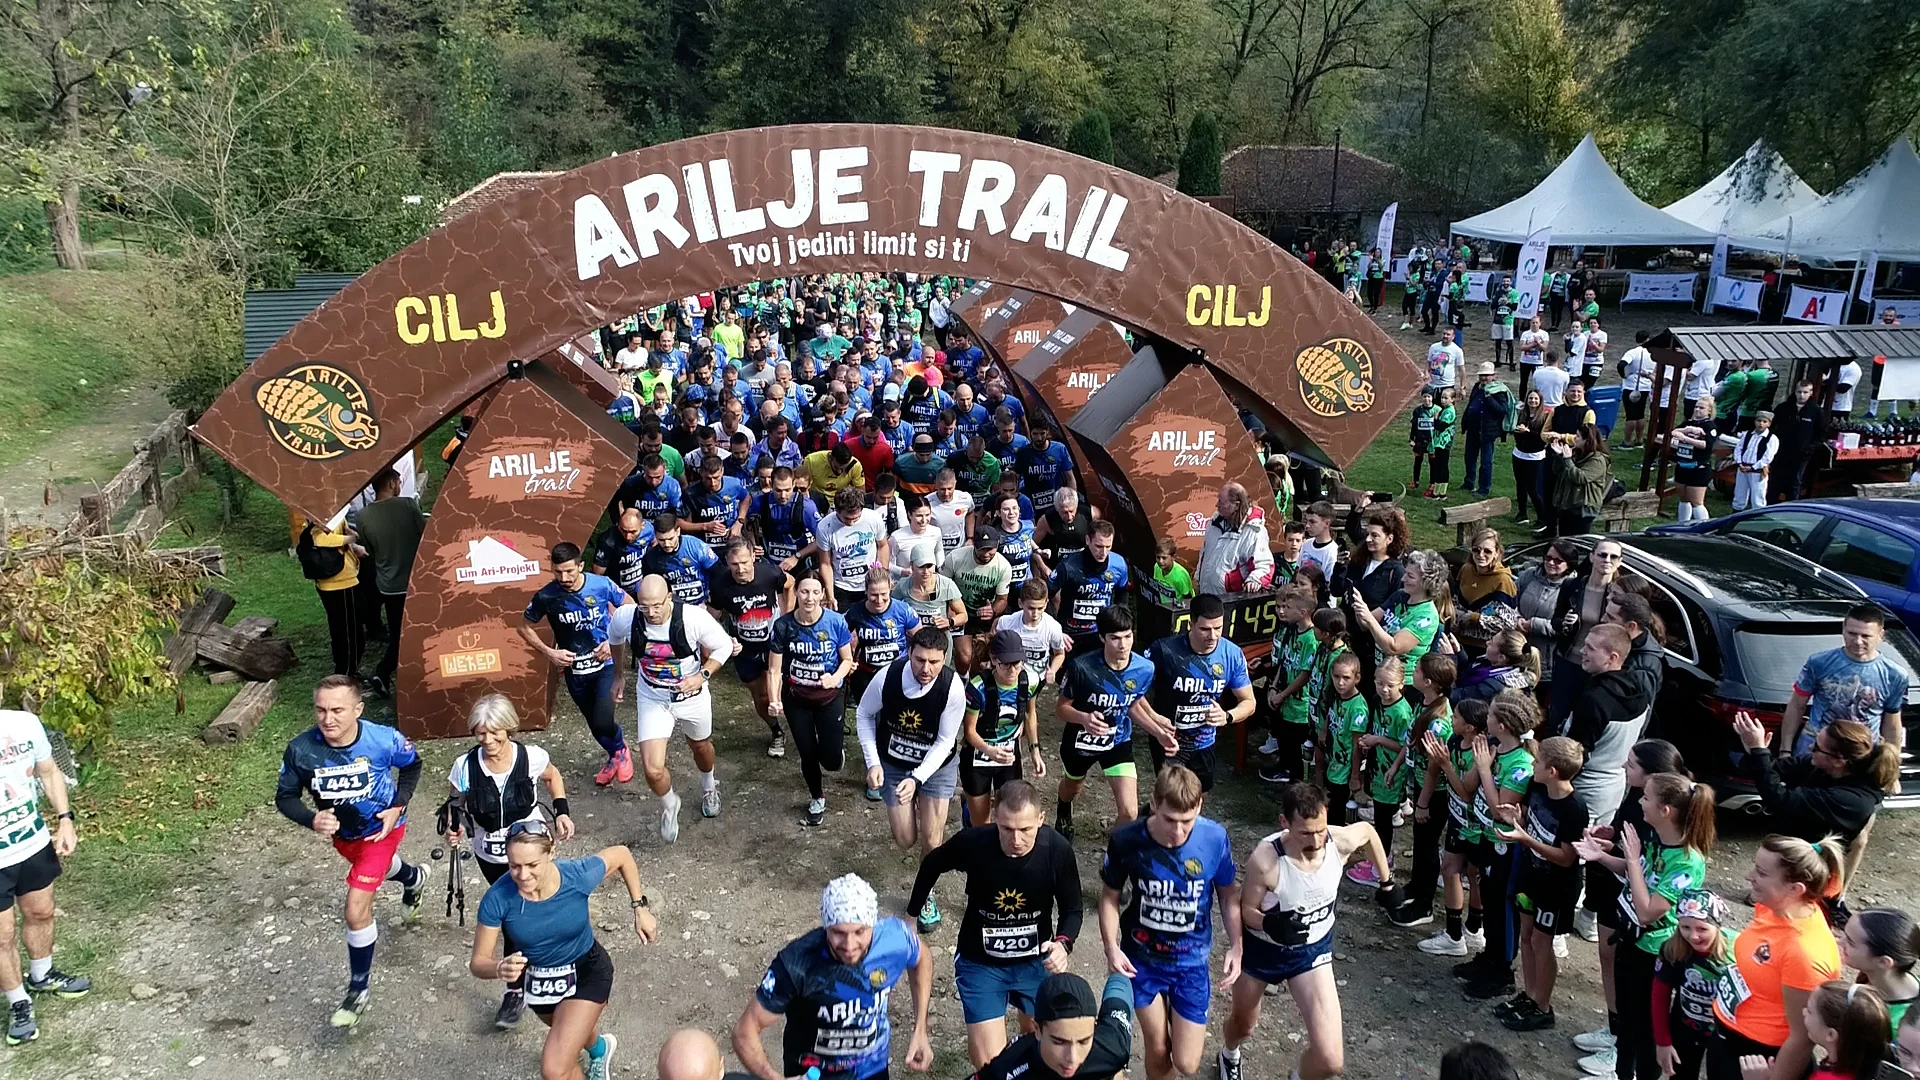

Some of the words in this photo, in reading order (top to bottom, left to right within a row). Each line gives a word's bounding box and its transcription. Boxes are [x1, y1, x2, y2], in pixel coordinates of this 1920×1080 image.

[573, 146, 870, 281] ARILJE
[909, 150, 1130, 272] TRAIL
[728, 236, 781, 267] Tvoj
[787, 231, 855, 265] jedini
[863, 230, 917, 257] limit
[924, 235, 946, 260] si
[952, 237, 971, 263] ti
[1186, 284, 1272, 328] CILJ
[1801, 295, 1827, 320] A1
[394, 290, 507, 344] CILJ
[1334, 341, 1369, 379] ARILJE
[306, 369, 366, 410] ARILJE
[1307, 391, 1336, 414] TRAIL
[284, 430, 329, 455] TRAIL
[1148, 430, 1216, 451] ARILJE
[488, 450, 573, 479] ARILJE
[1173, 448, 1220, 468] trail
[1028, 464, 1057, 474] ARILJE
[524, 468, 580, 494] trail
[634, 499, 669, 510] ARILJE
[700, 503, 733, 517] ARILJE
[1002, 540, 1031, 555] ARILJE
[459, 569, 478, 579] Lim
[480, 563, 537, 579] Ari-Projekt
[1078, 583, 1115, 594] ARILJE
[558, 606, 600, 624] ARILJE
[859, 627, 899, 640] ARILJE
[789, 641, 832, 655] ARILJE
[871, 651, 894, 662] 443
[795, 669, 819, 680] 528
[1173, 676, 1226, 694] ARILJE
[1087, 692, 1138, 708] ARILJE
[1083, 734, 1110, 745] 477
[895, 744, 922, 758] 421
[327, 775, 363, 790] 441
[1150, 908, 1187, 924] 454
[1536, 907, 1555, 928] 10
[993, 938, 1030, 950] 420
[531, 979, 568, 995] 546
